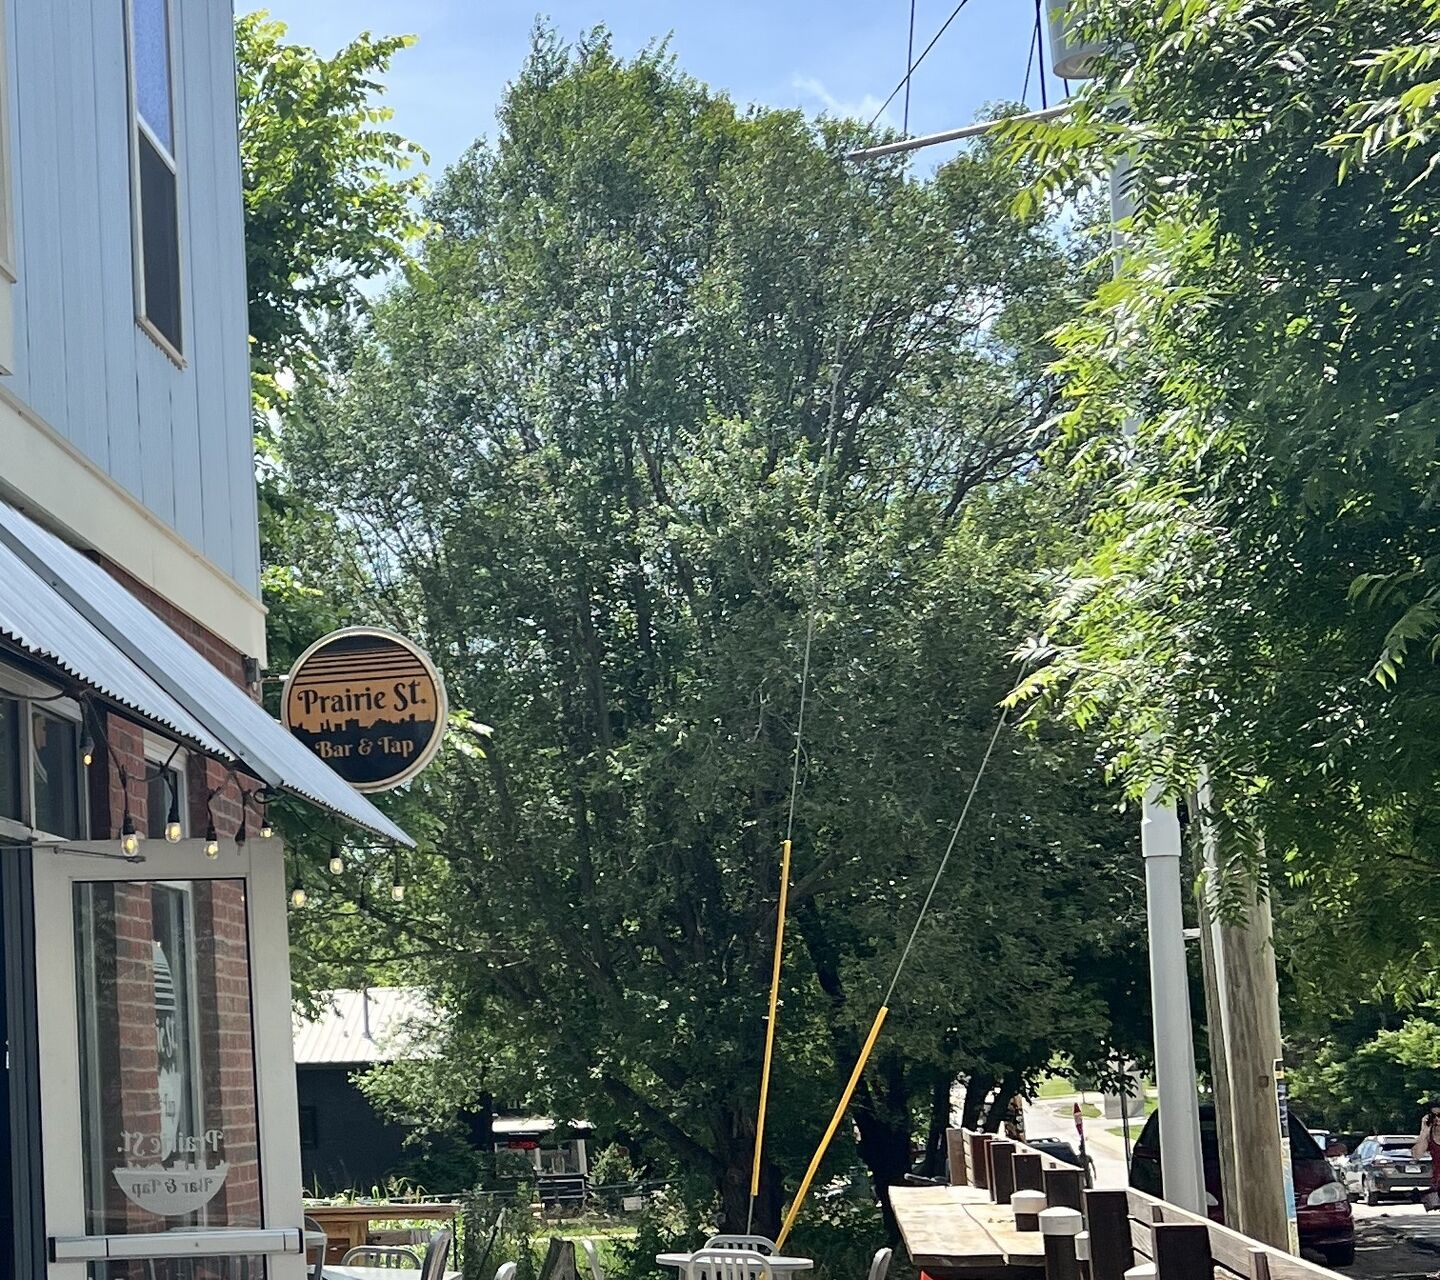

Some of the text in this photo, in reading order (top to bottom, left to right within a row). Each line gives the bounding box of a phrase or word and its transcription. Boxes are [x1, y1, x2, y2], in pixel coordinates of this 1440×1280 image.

[297, 679, 427, 715] Prairie St.
[315, 736, 414, 758] Bar & Tap
